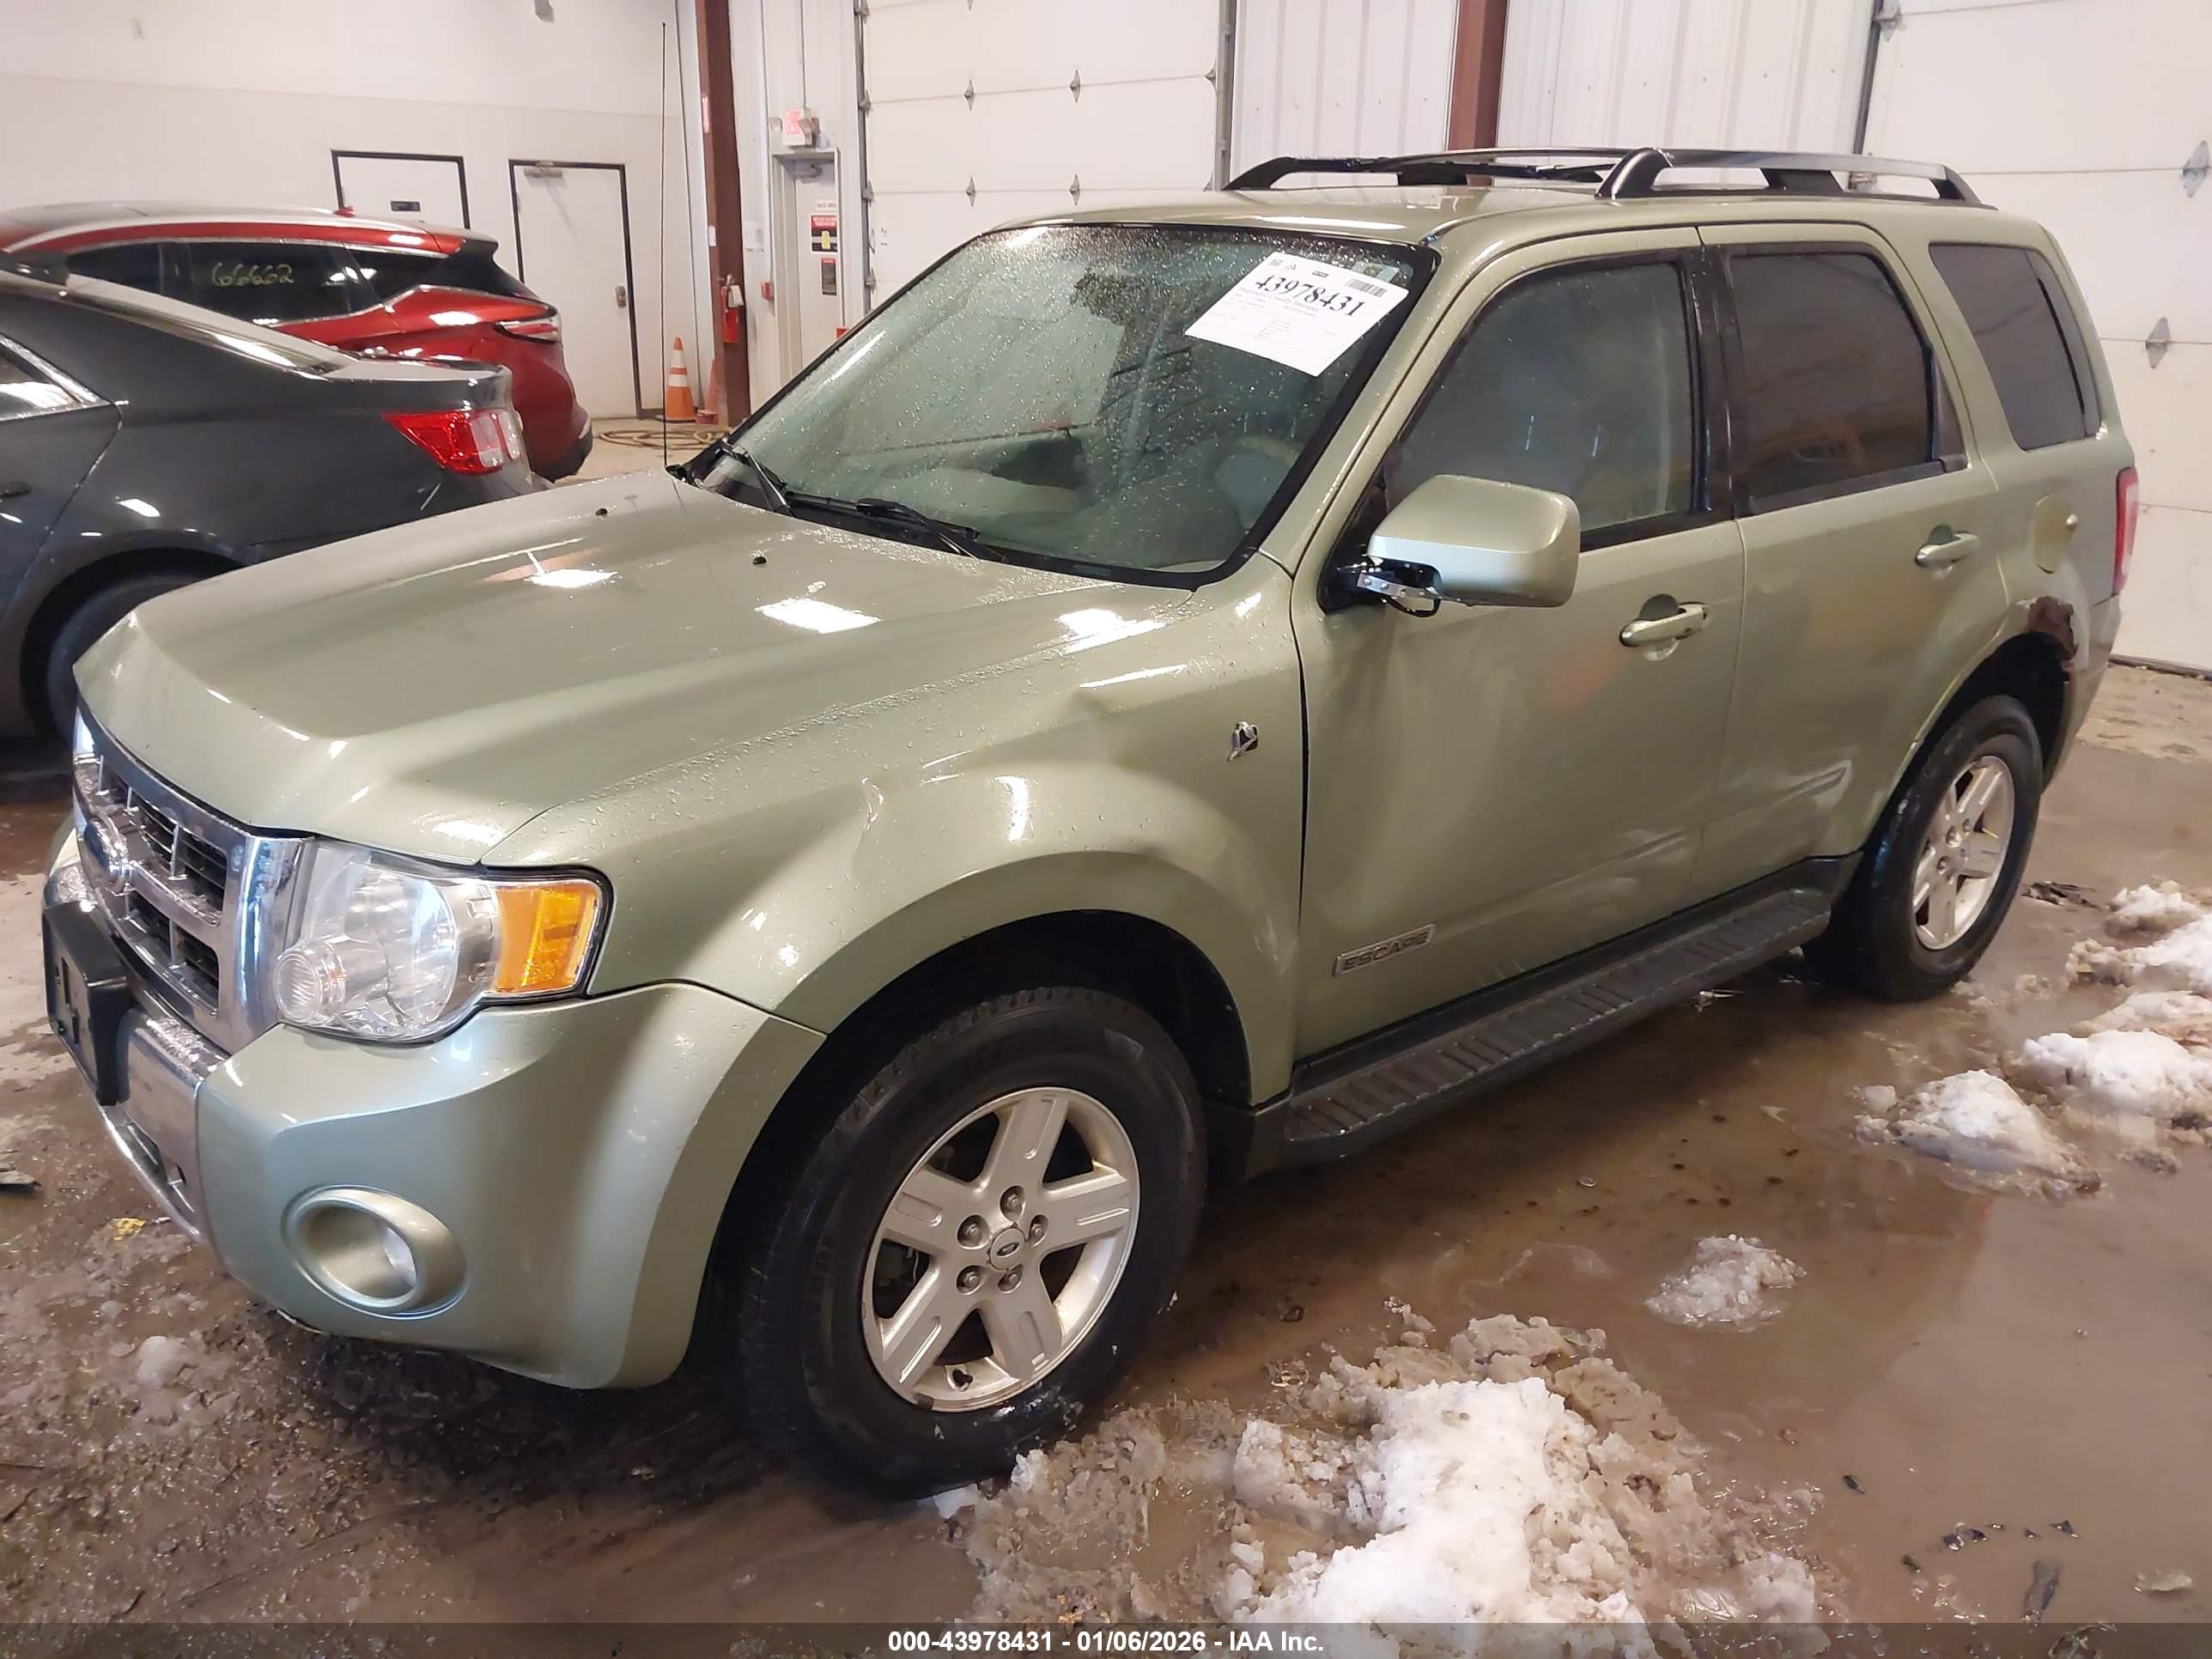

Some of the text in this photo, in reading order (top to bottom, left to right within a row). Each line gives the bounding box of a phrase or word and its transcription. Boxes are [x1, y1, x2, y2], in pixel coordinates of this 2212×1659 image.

[211, 262, 295, 287] 66662
[1255, 274, 1366, 317] 43978431
[1342, 931, 1428, 970] ESCAPE
